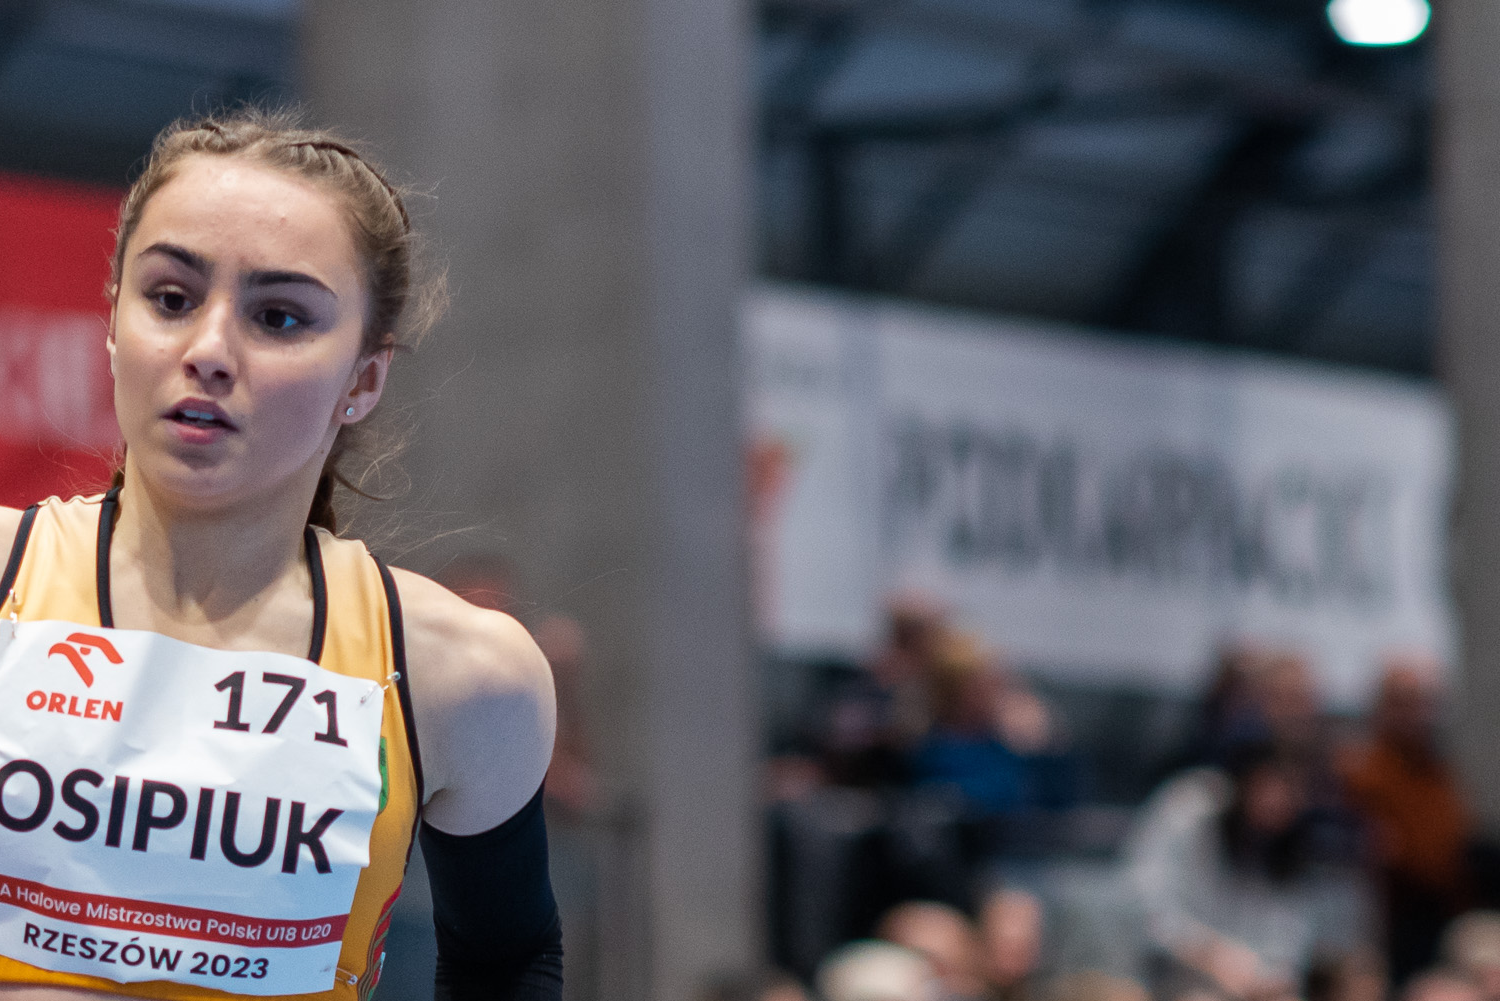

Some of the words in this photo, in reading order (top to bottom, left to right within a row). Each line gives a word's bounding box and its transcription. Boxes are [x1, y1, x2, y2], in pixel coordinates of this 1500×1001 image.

[25, 690, 124, 722] ORLEN
[213, 670, 349, 748] 171
[16, 886, 82, 916] Halowe
[86, 902, 201, 932] Mistrzostwa
[206, 918, 263, 941] Polski
[266, 925, 298, 942] U18
[301, 923, 332, 941] U20
[23, 922, 184, 972] RZESZÓW
[189, 951, 270, 980] 2023
